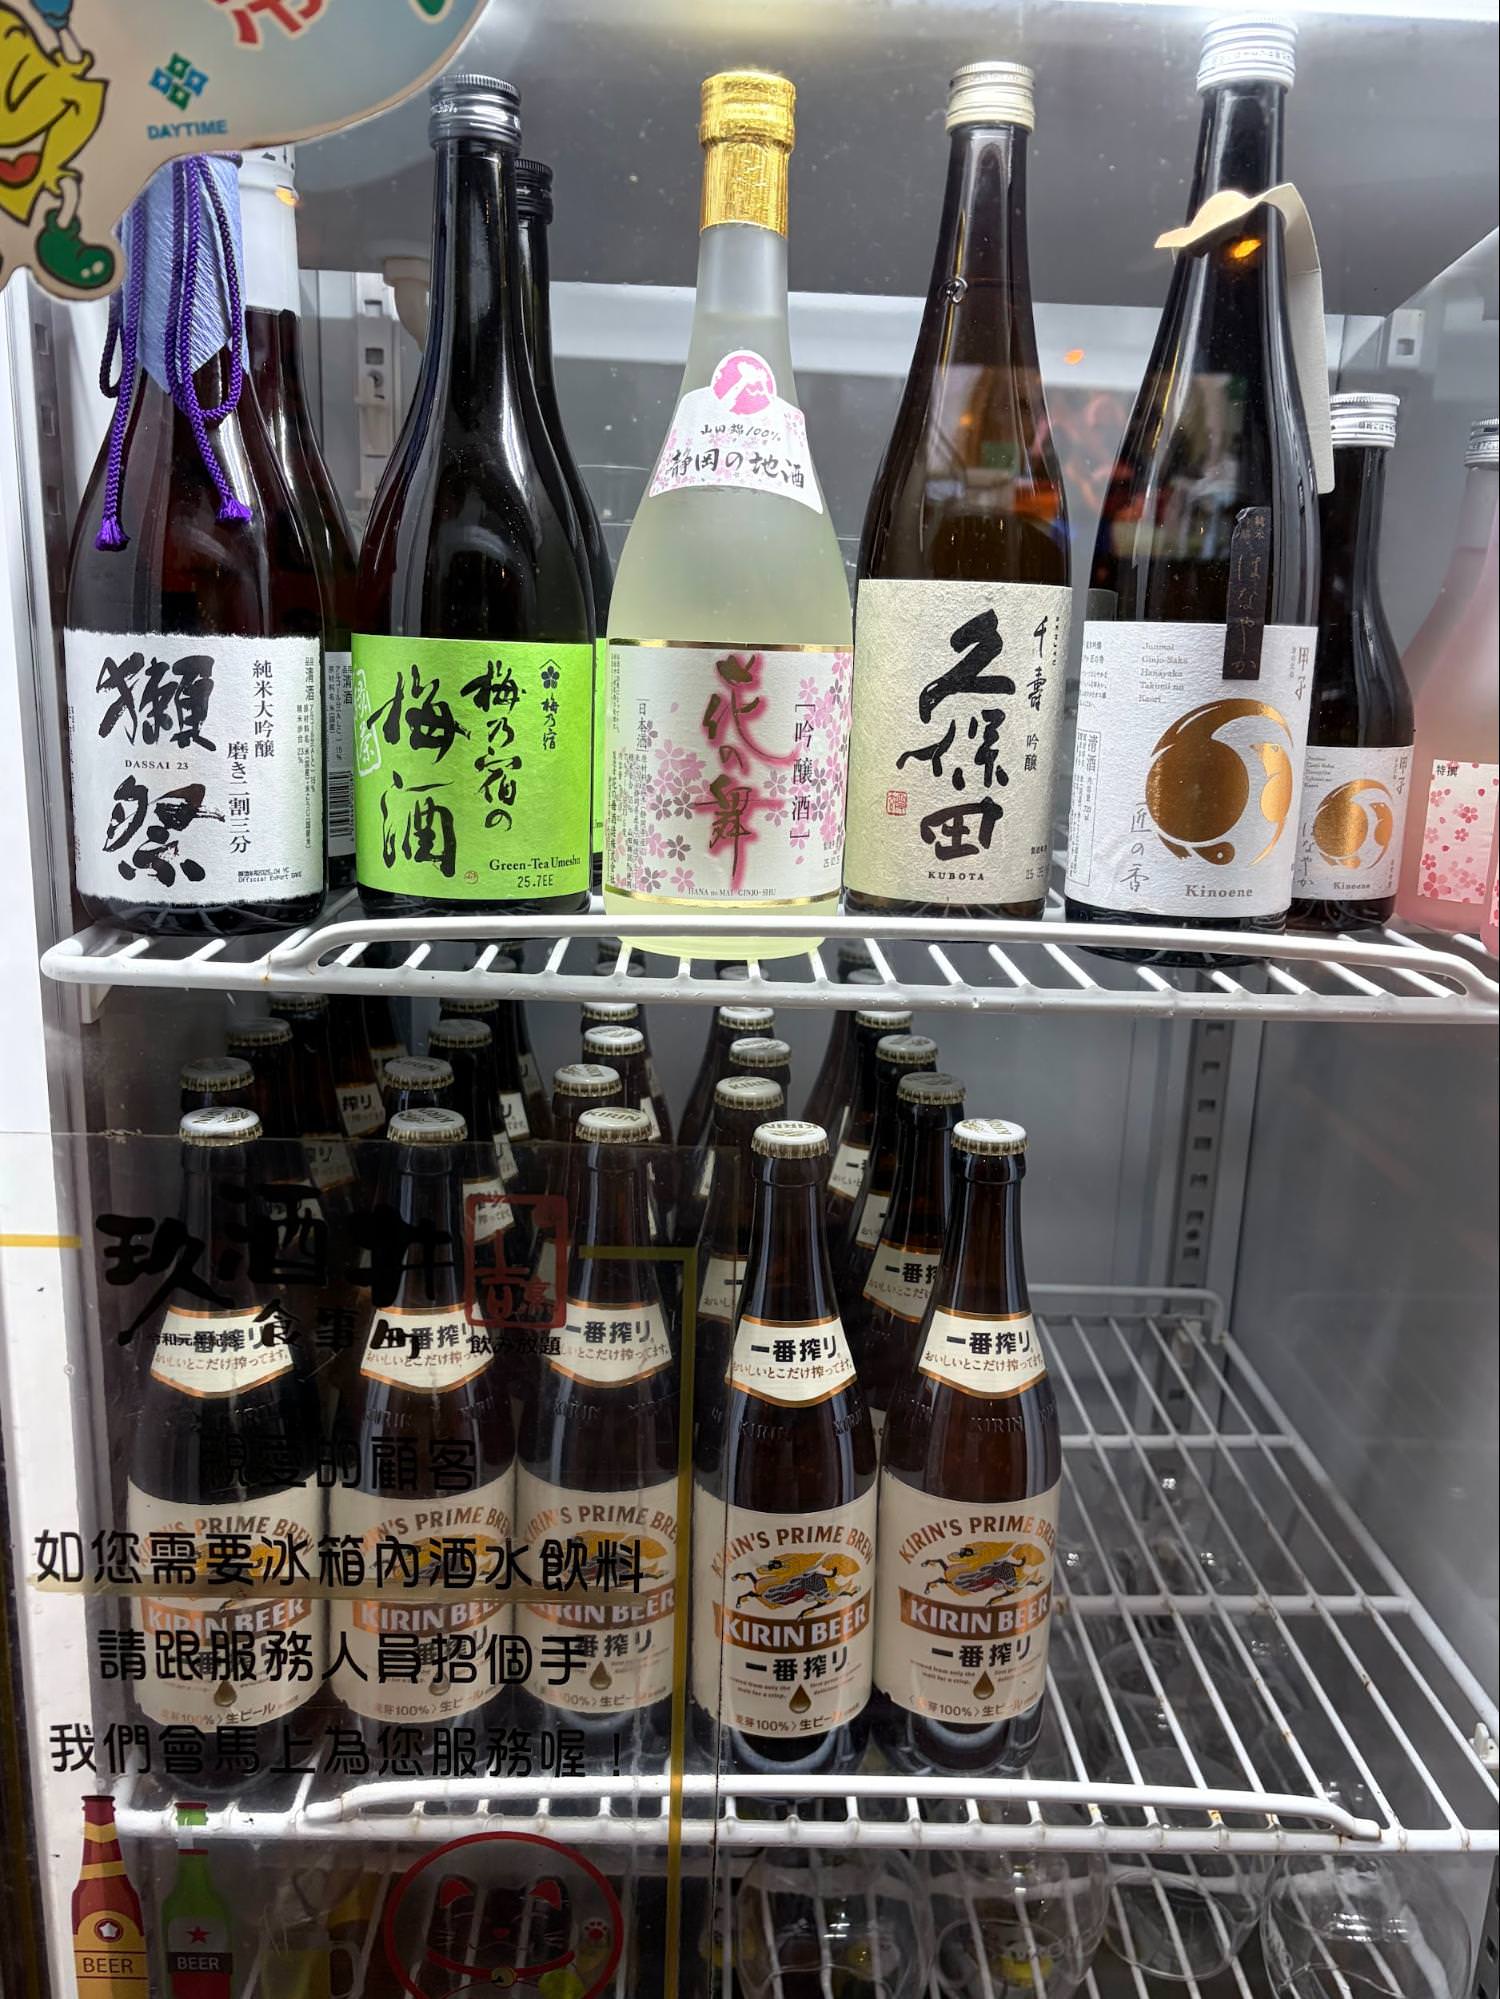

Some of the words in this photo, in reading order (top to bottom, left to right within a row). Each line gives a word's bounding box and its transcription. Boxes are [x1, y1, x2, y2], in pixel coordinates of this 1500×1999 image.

[147, 120, 228, 140] DAYTIME
[665, 448, 805, 488] 静岡の地酒
[252, 659, 275, 758] 純米大吟醸
[542, 695, 560, 751] 梅乃宿
[460, 660, 527, 833] 梅乃宿の
[897, 609, 1016, 861] 久保田
[1024, 733, 1040, 771] 吟醸
[124, 759, 170, 770] DASSAI
[176, 762, 189, 770] 23
[366, 664, 472, 878] 梅酒
[226, 740, 251, 855] 磨き二割三分
[489, 858, 550, 871] Green-Tea
[927, 870, 985, 882] KUBOTA
[1184, 884, 1253, 898] Kinoene
[470, 1336, 561, 1355] 飲み放題
[566, 1321, 651, 1344] 一番搾り
[751, 1336, 837, 1362] 一番搾り
[946, 1330, 1030, 1355] 一番搾り
[195, 1515, 270, 1535] PRIME
[415, 1506, 484, 1530] PRIME
[578, 1505, 648, 1526] PRIME
[712, 1530, 770, 1577] KIRIN'S
[777, 1526, 845, 1546] PRIME
[848, 1528, 873, 1565] BREW
[899, 1518, 963, 1564] KIRIN'S
[969, 1515, 1033, 1534] PRIME
[35, 1529, 642, 1594] 如您需要冰箱內酒水飲料
[234, 1599, 305, 1635] BEER
[362, 1601, 445, 1631] KIRIN
[724, 1616, 805, 1647] KIRIN
[811, 1604, 866, 1642] BEER
[910, 1600, 992, 1633] KIRIN
[997, 1594, 1050, 1632] BEER
[98, 1629, 587, 1684] 請跟服務人員招個手
[745, 1646, 848, 1682] 一番搾り
[931, 1635, 1031, 1668] 一番搾り
[83, 1956, 133, 1974] BEER
[177, 1956, 219, 1971] BEER
